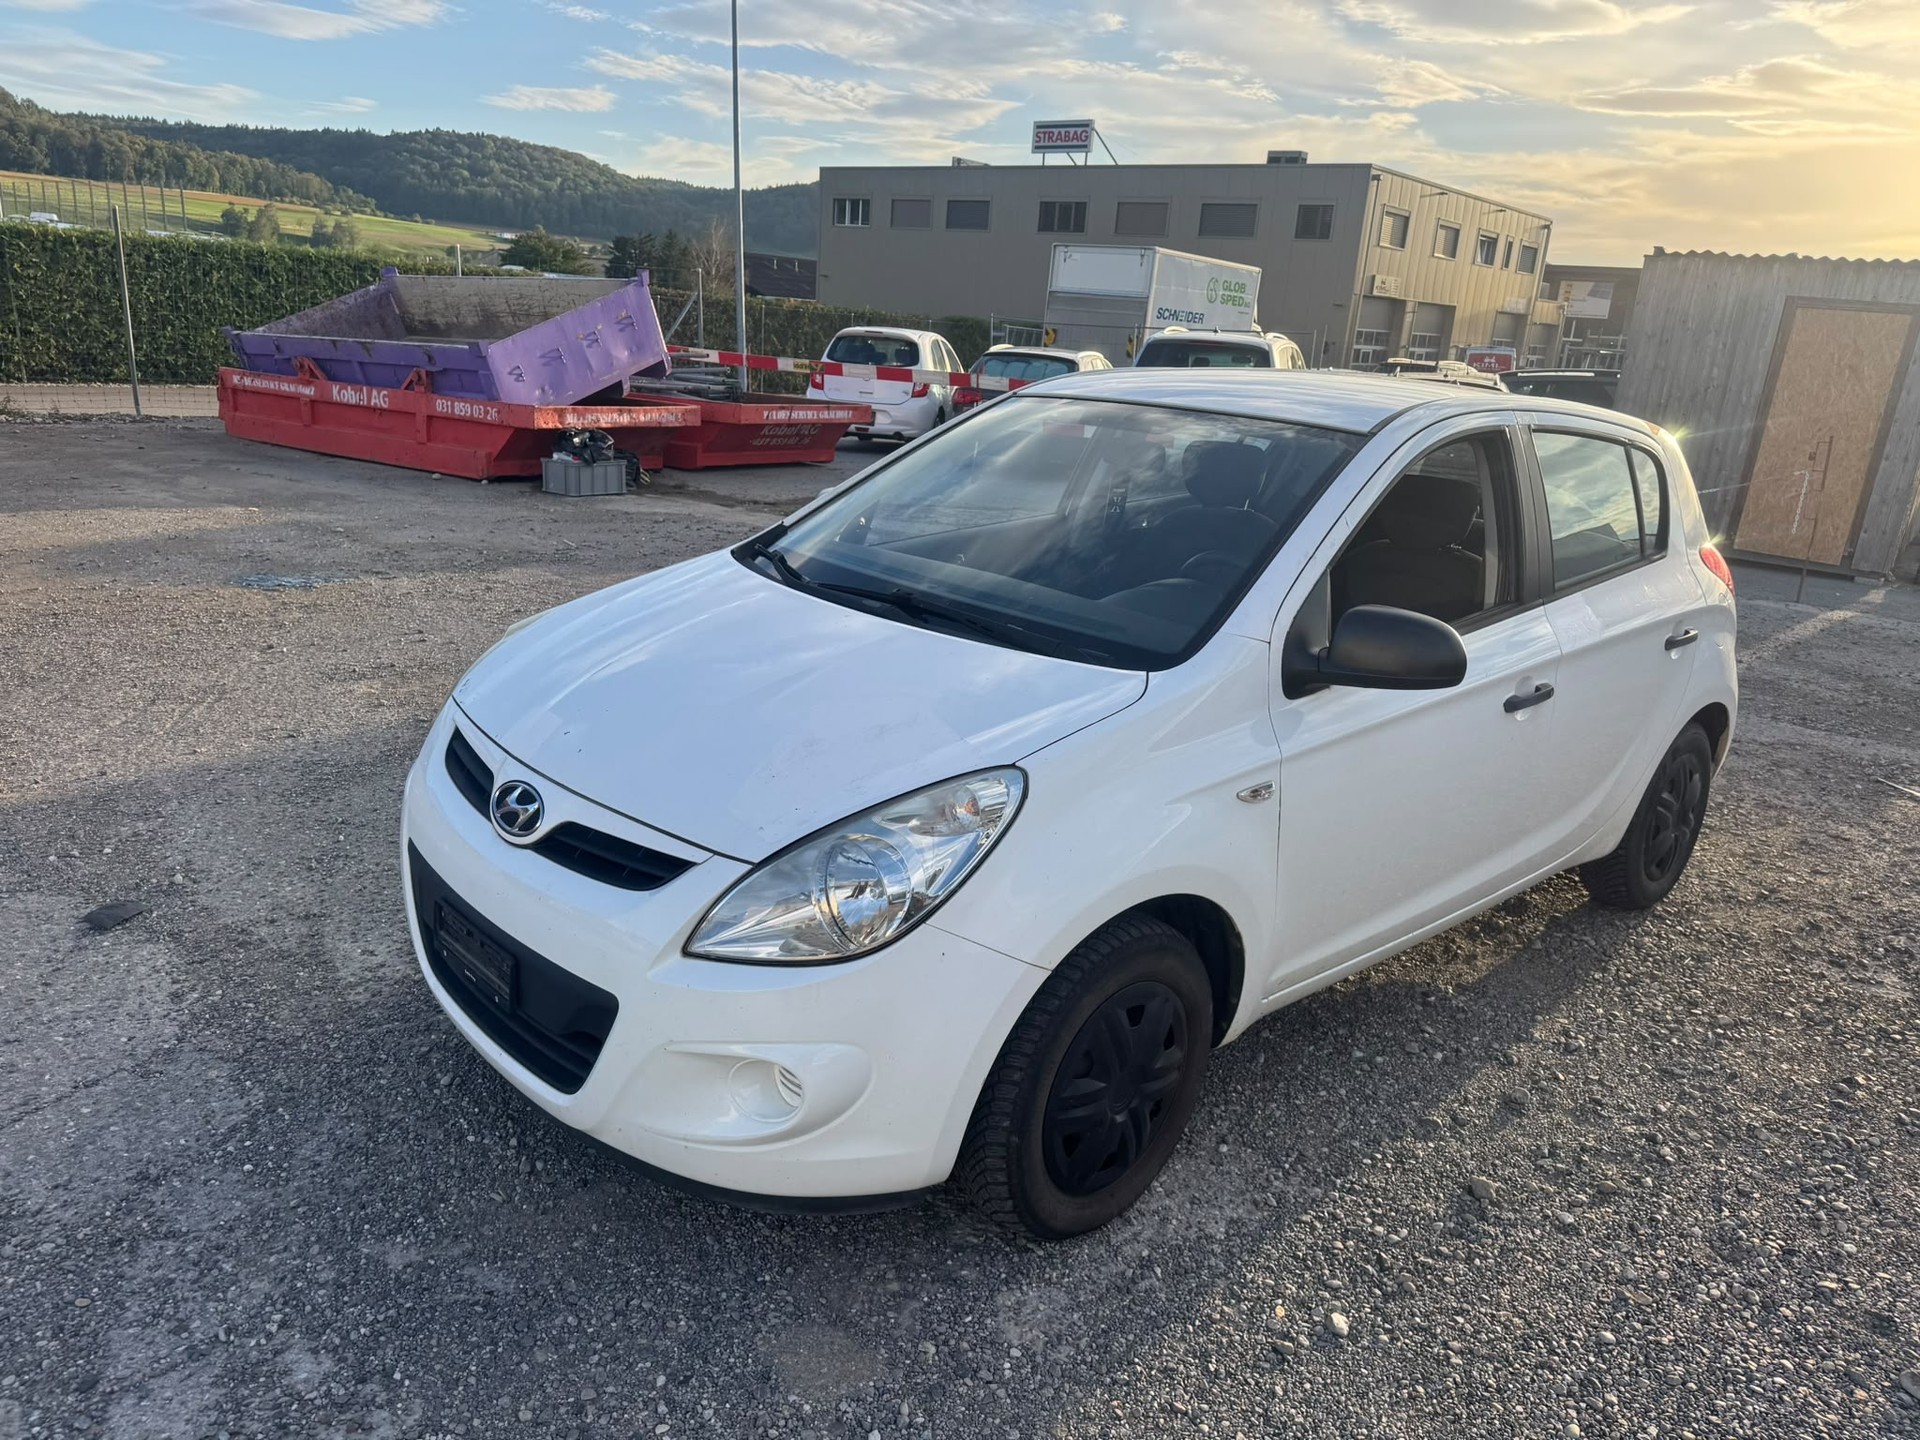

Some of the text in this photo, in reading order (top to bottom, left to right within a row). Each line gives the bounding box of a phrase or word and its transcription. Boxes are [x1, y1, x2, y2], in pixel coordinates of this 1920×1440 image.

[1035, 129, 1089, 143] STRABAG
[1222, 280, 1247, 294] GLOB
[1220, 293, 1245, 308] SPED
[1156, 307, 1205, 324] SCHNEIDER
[332, 384, 389, 408] Kobel AG
[436, 399, 452, 414] 031
[454, 401, 471, 416] 859
[473, 406, 485, 418] 03
